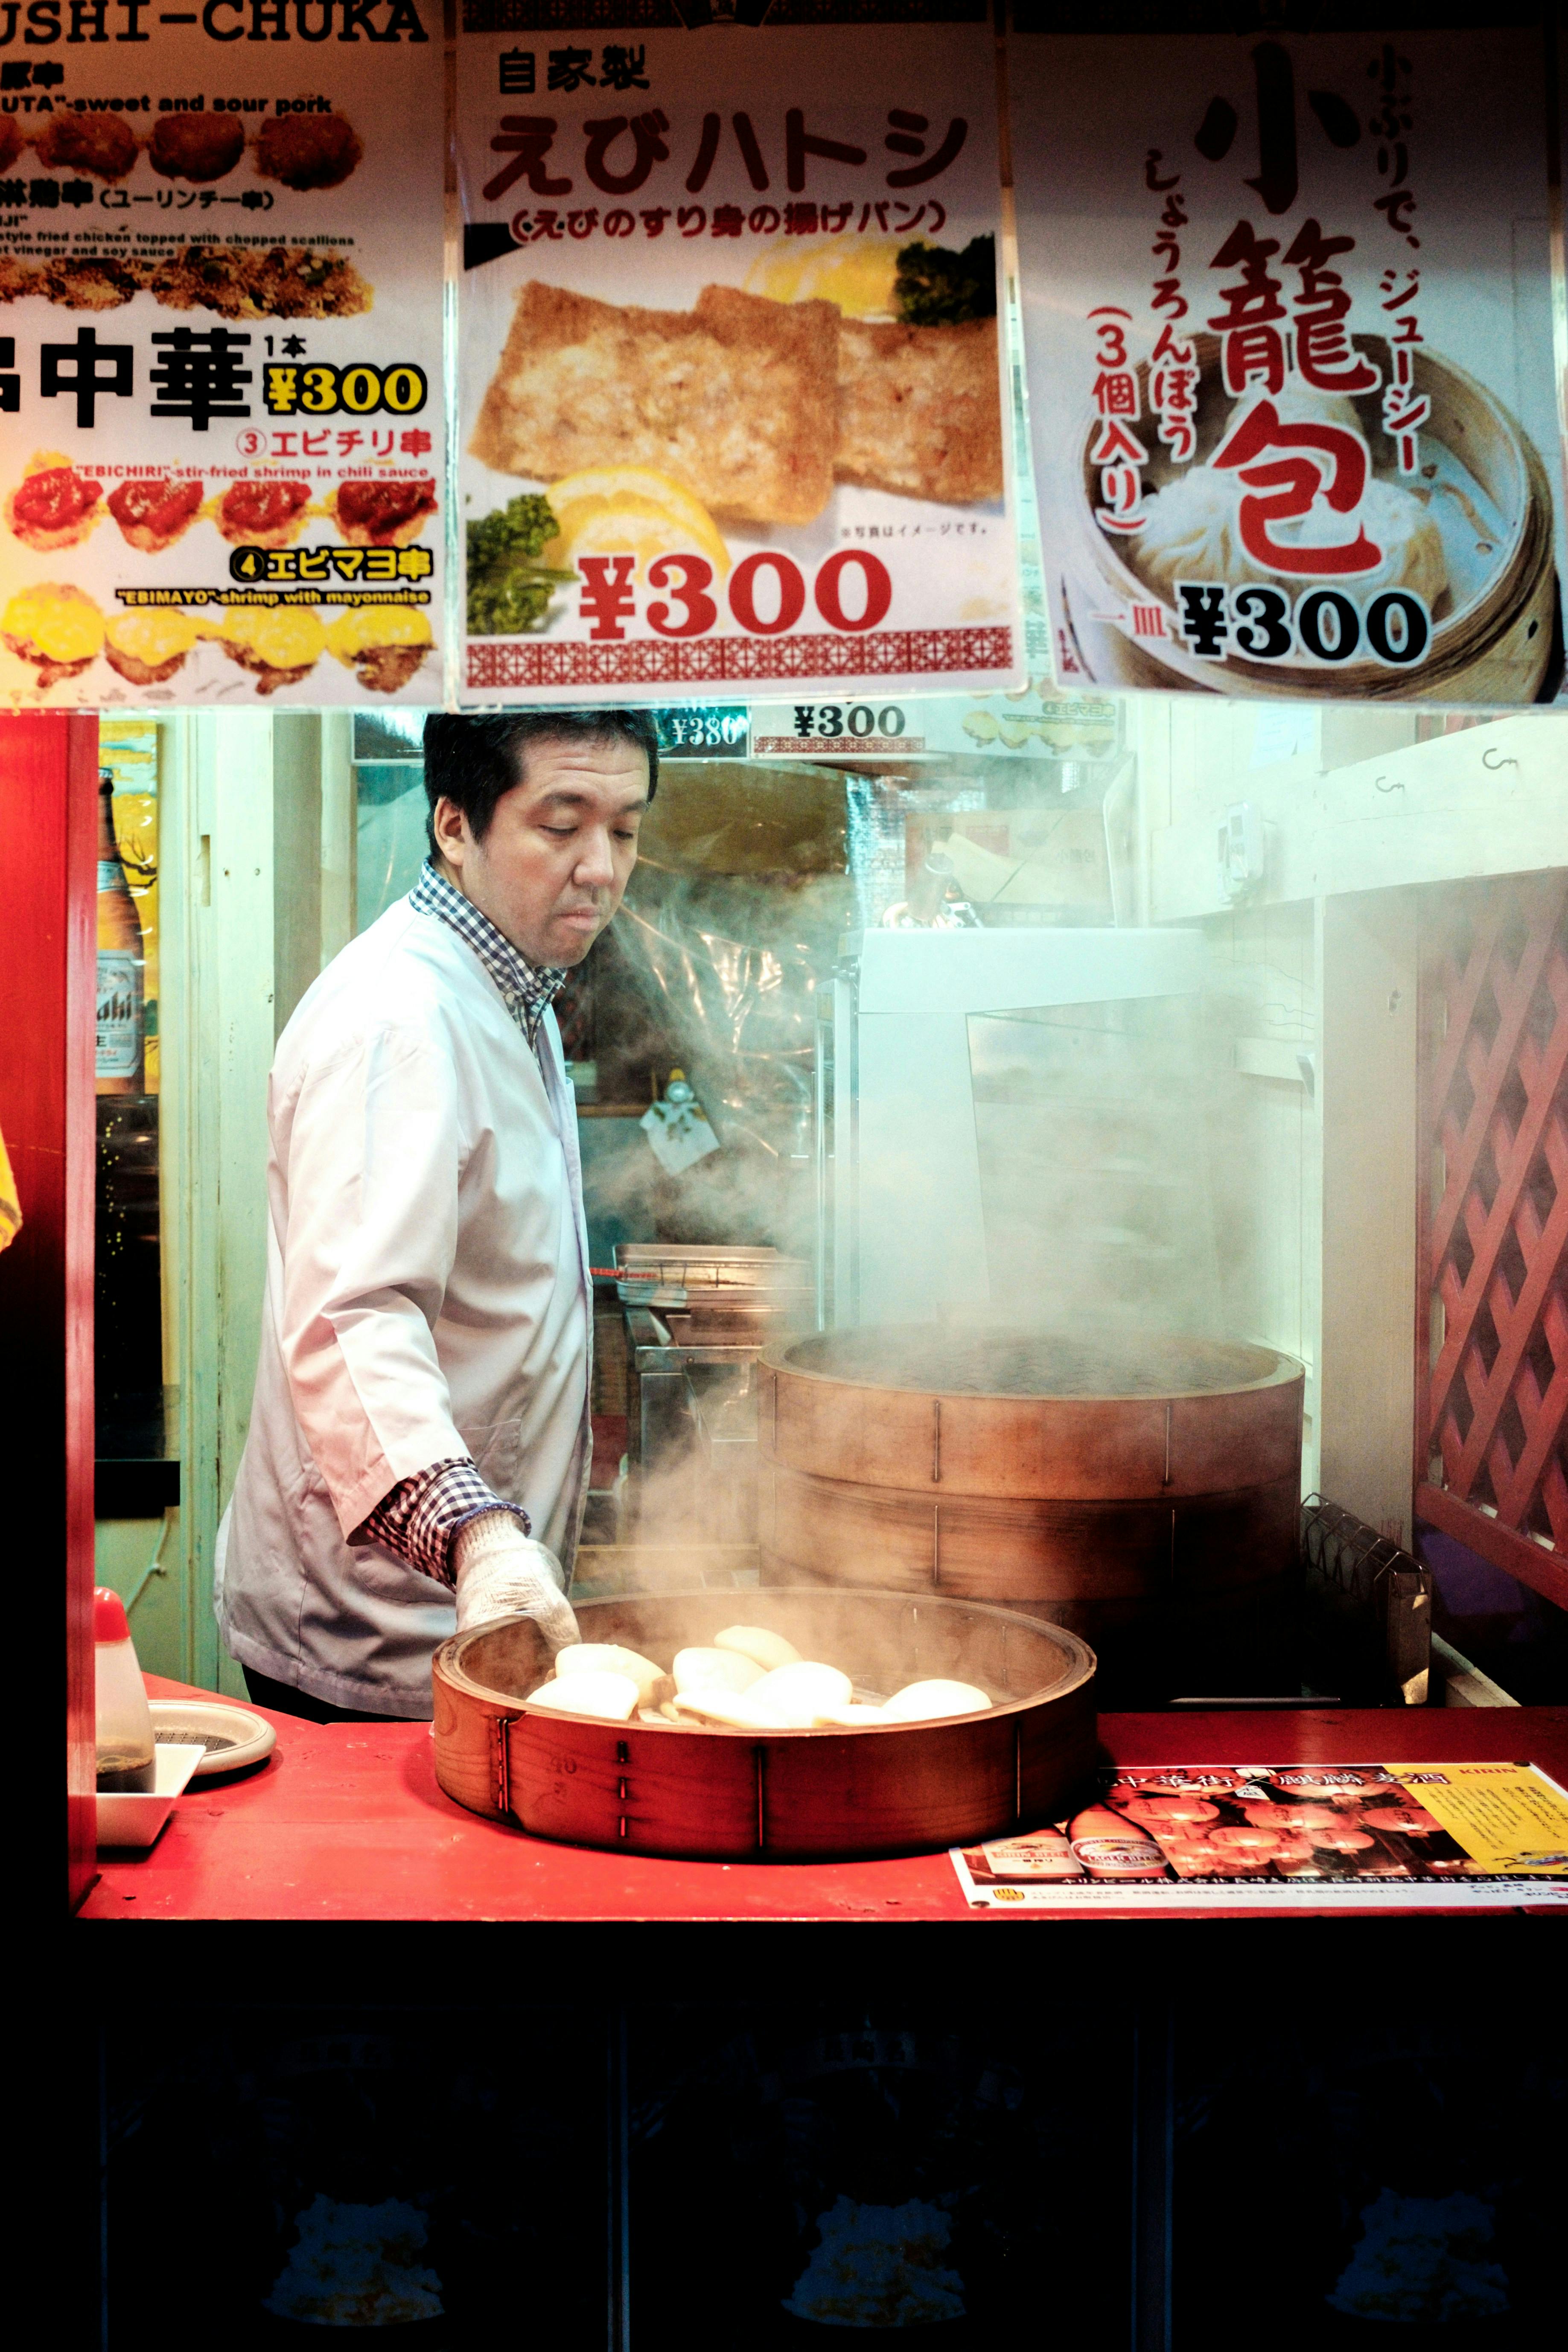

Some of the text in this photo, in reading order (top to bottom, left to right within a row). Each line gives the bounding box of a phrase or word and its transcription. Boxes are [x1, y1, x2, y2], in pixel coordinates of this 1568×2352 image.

[499, 44, 650, 94] 自家製
[159, 94, 204, 112] and
[213, 98, 268, 112] sour
[276, 95, 332, 116] pork
[482, 108, 968, 201] えびハトシ
[37, 232, 69, 242] fried
[75, 232, 130, 242] chicken
[137, 233, 185, 244] topped
[190, 233, 220, 243] with
[226, 234, 286, 246] chopped
[291, 236, 354, 245] scallions
[511, 199, 946, 242] (えびのすり身の揚げパン)
[14, 245, 66, 256] vinegar
[72, 246, 97, 255] and
[102, 248, 126, 257] soy
[132, 248, 175, 256] sauce
[1145, 149, 1195, 458] しょうろんぽう
[1195, 41, 1383, 574] 小籠包
[264, 335, 306, 357] 1本
[0, 327, 252, 430] 中華
[265, 364, 426, 414] ¥300
[1087, 306, 1147, 530] (3個入り)
[255, 466, 311, 479] shrimp
[317, 466, 331, 478] in
[338, 466, 373, 478] chili
[379, 468, 428, 478] sauce
[284, 590, 321, 604] with
[326, 589, 429, 606] mayonnaise
[578, 549, 892, 640] ¥300
[1180, 585, 1428, 663] ¥300
[672, 717, 737, 746] ¥380
[794, 705, 905, 737] ¥300
